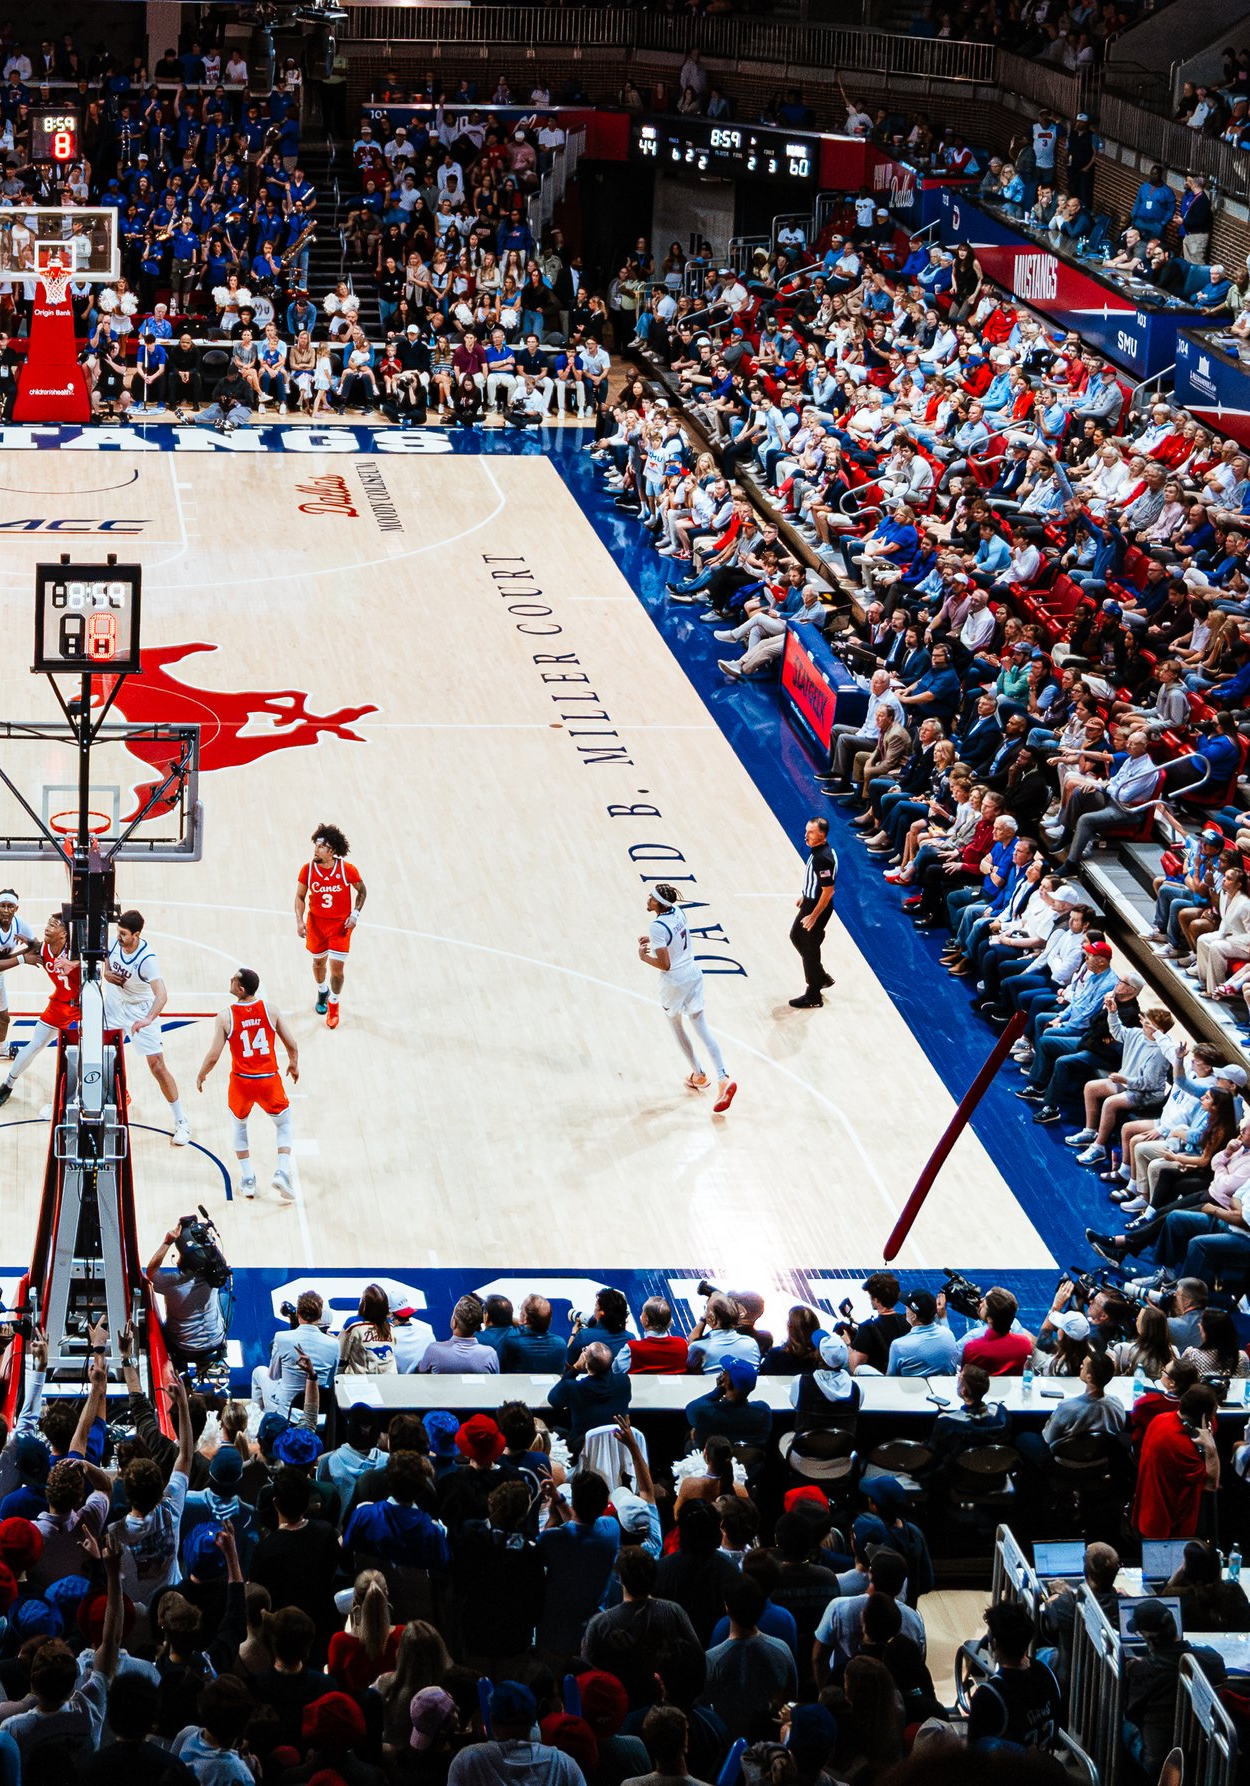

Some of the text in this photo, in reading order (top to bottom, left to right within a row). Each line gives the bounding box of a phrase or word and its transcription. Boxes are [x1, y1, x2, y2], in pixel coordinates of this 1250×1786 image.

[44, 117, 75, 132] 8:59
[54, 133, 71, 159] 8
[638, 139, 657, 156] 44
[710, 129, 742, 149] 8:59
[685, 149, 694, 163] 2
[698, 156, 709, 171] 2
[747, 157, 778, 174] 2 3
[789, 159, 811, 177] 60
[1013, 253, 1058, 300] MUSTANGS
[34, 308, 54, 317] Origin
[1117, 330, 1138, 358] SMU
[294, 473, 360, 517] Dallas
[369, 500, 405, 532] MOODY
[482, 553, 563, 636] COURT
[87, 612, 118, 653] 8
[533, 653, 635, 766] MILLER
[607, 789, 662, 818] B.
[311, 882, 342, 893] Canes
[321, 894, 333, 908] 3
[681, 928, 688, 950] 7
[112, 961, 133, 979] SMU
[57, 975, 71, 991] 7
[240, 1028, 270, 1058] 14
